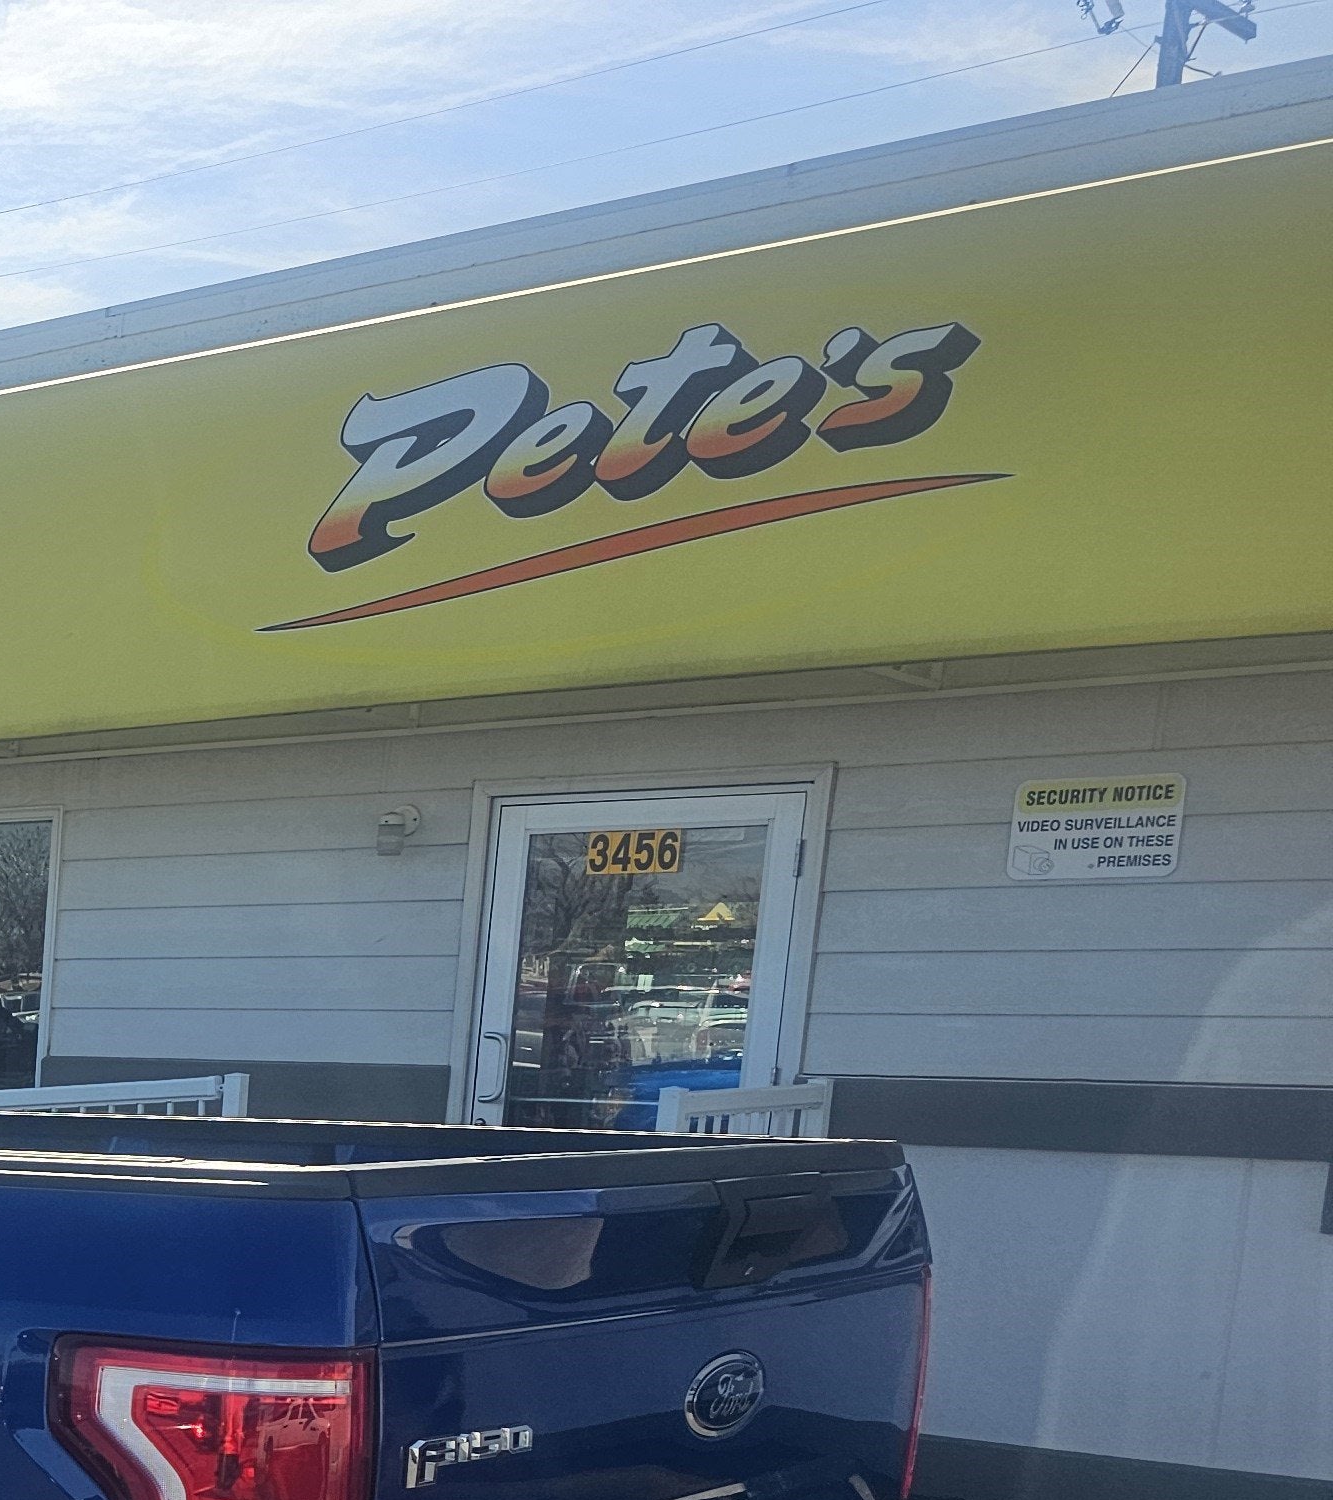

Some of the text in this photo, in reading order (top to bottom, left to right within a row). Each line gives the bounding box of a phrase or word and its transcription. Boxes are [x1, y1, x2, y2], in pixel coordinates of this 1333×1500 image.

[307, 321, 981, 573] Pete's
[1026, 784, 1176, 806] SECURITY NOTICE
[1017, 814, 1177, 833] VIDEO SURVEILLANCE
[589, 831, 678, 872] 3456
[1053, 834, 1174, 850] IN USE ON THESE
[1096, 854, 1172, 868] PREMISES
